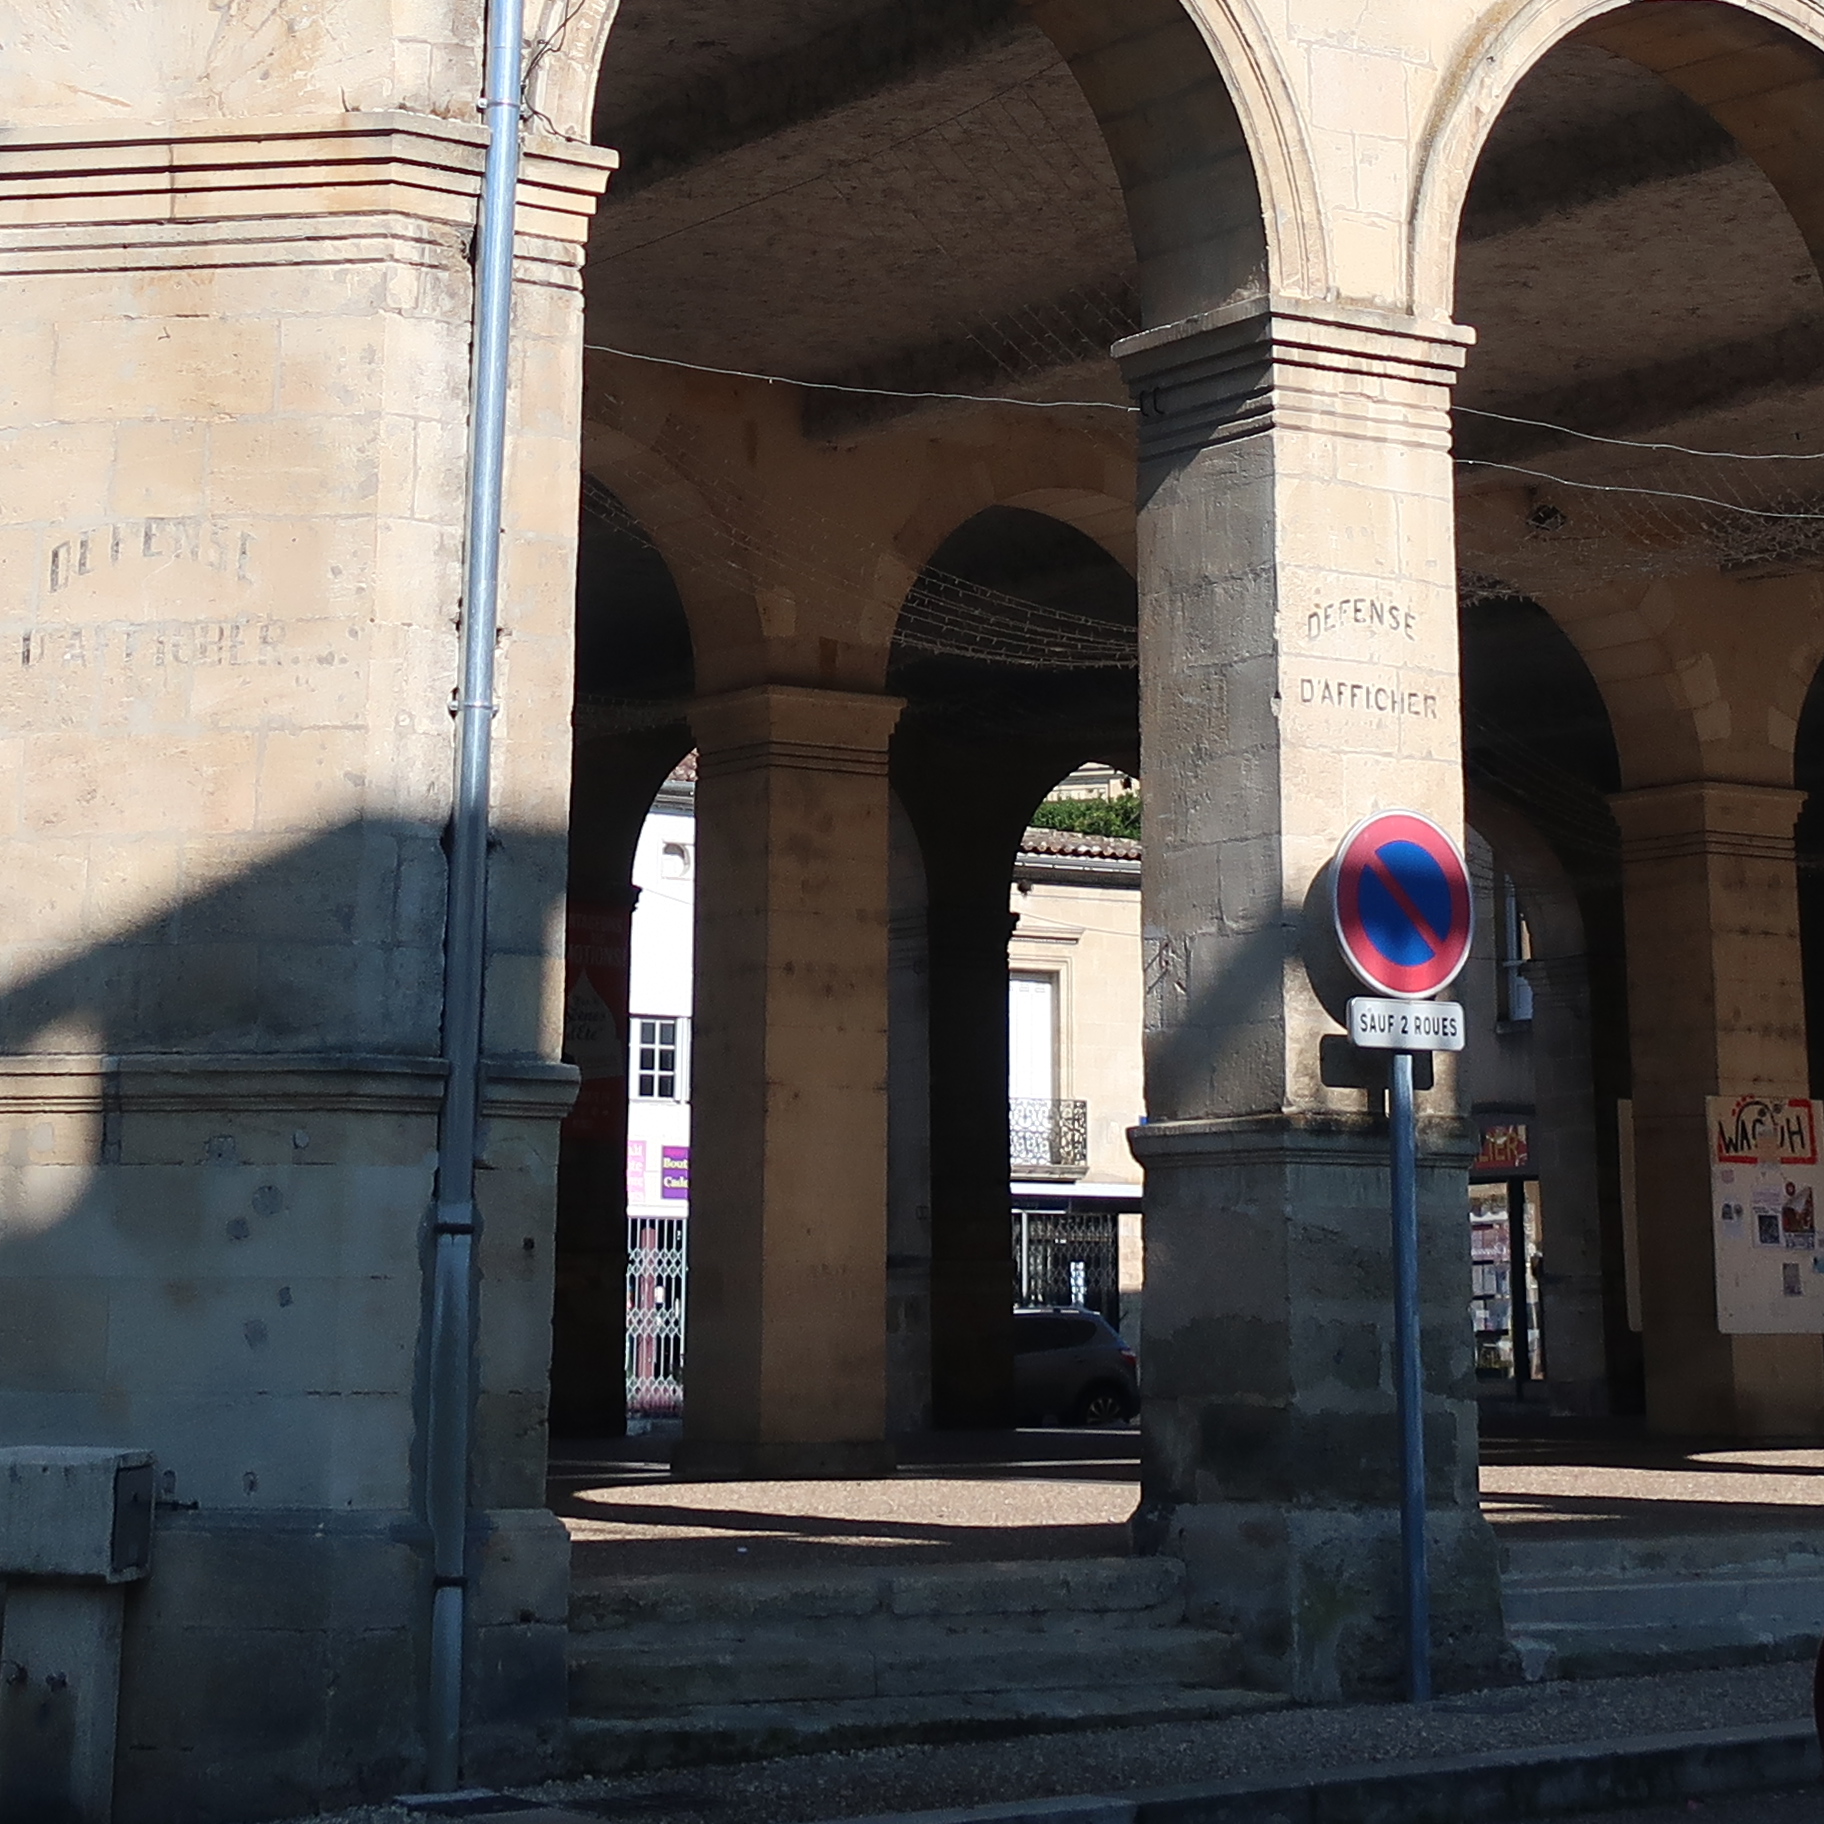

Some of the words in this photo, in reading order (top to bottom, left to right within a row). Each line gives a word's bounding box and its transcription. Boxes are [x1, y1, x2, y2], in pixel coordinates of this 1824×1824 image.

[1307, 597, 1416, 642] DEFENSE
[1300, 677, 1438, 720] D'AFFICHER
[1359, 1012, 1395, 1033] SAUF
[1400, 1014, 1409, 1035] 2
[1414, 1015, 1458, 1037] ROUES
